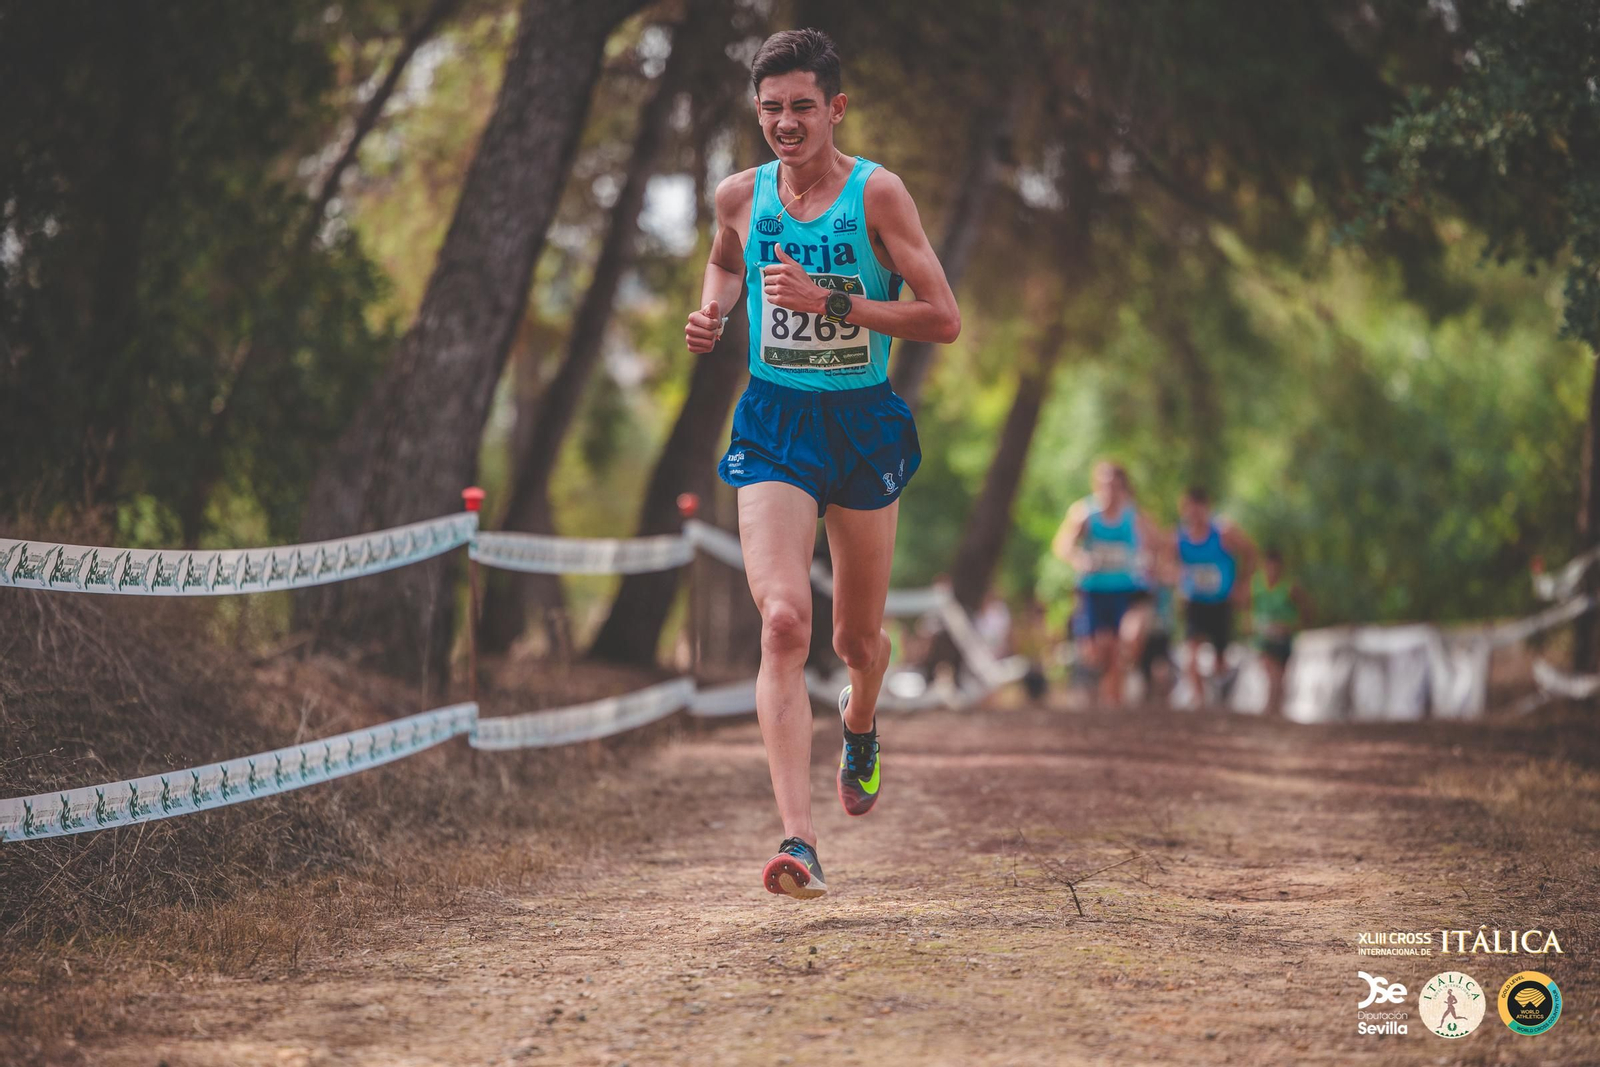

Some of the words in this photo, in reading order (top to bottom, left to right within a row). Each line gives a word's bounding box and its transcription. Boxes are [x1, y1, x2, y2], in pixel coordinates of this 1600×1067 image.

[758, 219, 783, 233] TROPS
[833, 213, 858, 231] als
[758, 235, 858, 273] nerja
[771, 308, 861, 341] 8269
